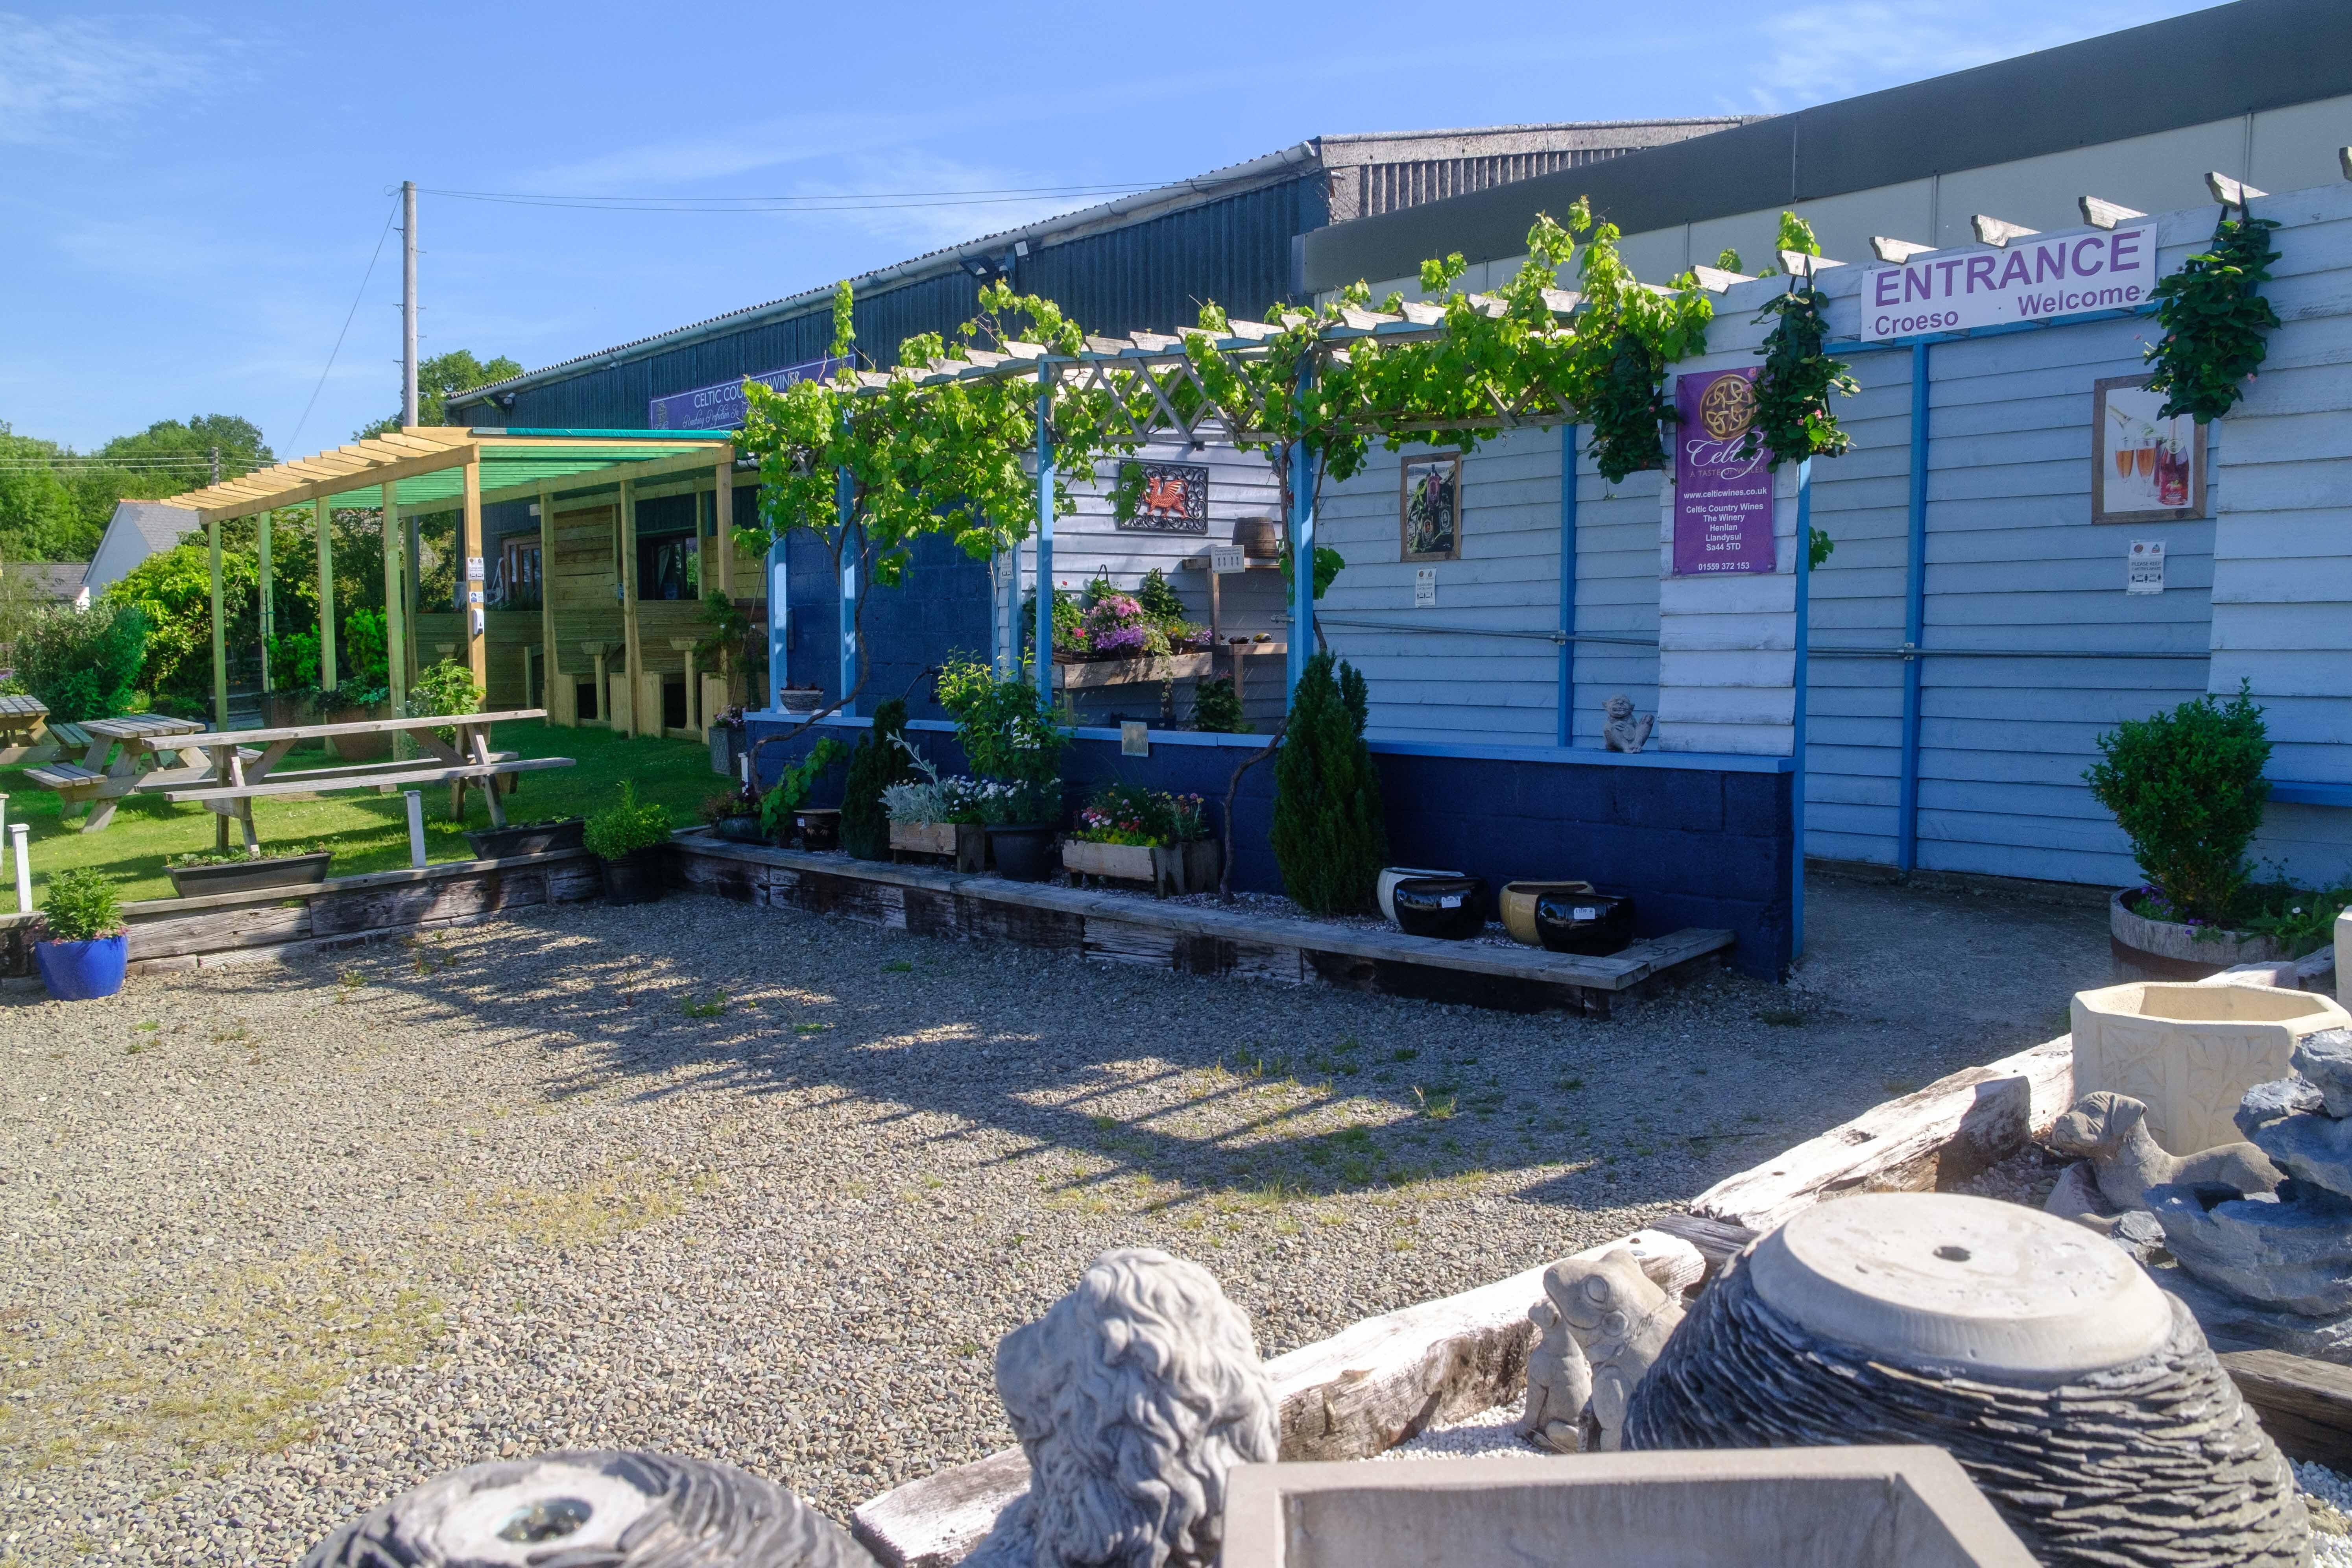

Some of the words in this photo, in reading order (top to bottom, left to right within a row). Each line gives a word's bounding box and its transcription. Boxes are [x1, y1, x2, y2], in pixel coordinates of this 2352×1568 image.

[1875, 231, 2142, 307] ENTRANCE
[1875, 310, 1959, 335] Croeso
[2018, 284, 2140, 316] Welcome
[694, 389, 721, 408] CELTIC
[1684, 487, 1767, 499] www.celticwines.co.uk
[1719, 514, 1745, 522] Winery
[1706, 533, 1741, 542] Llandysul
